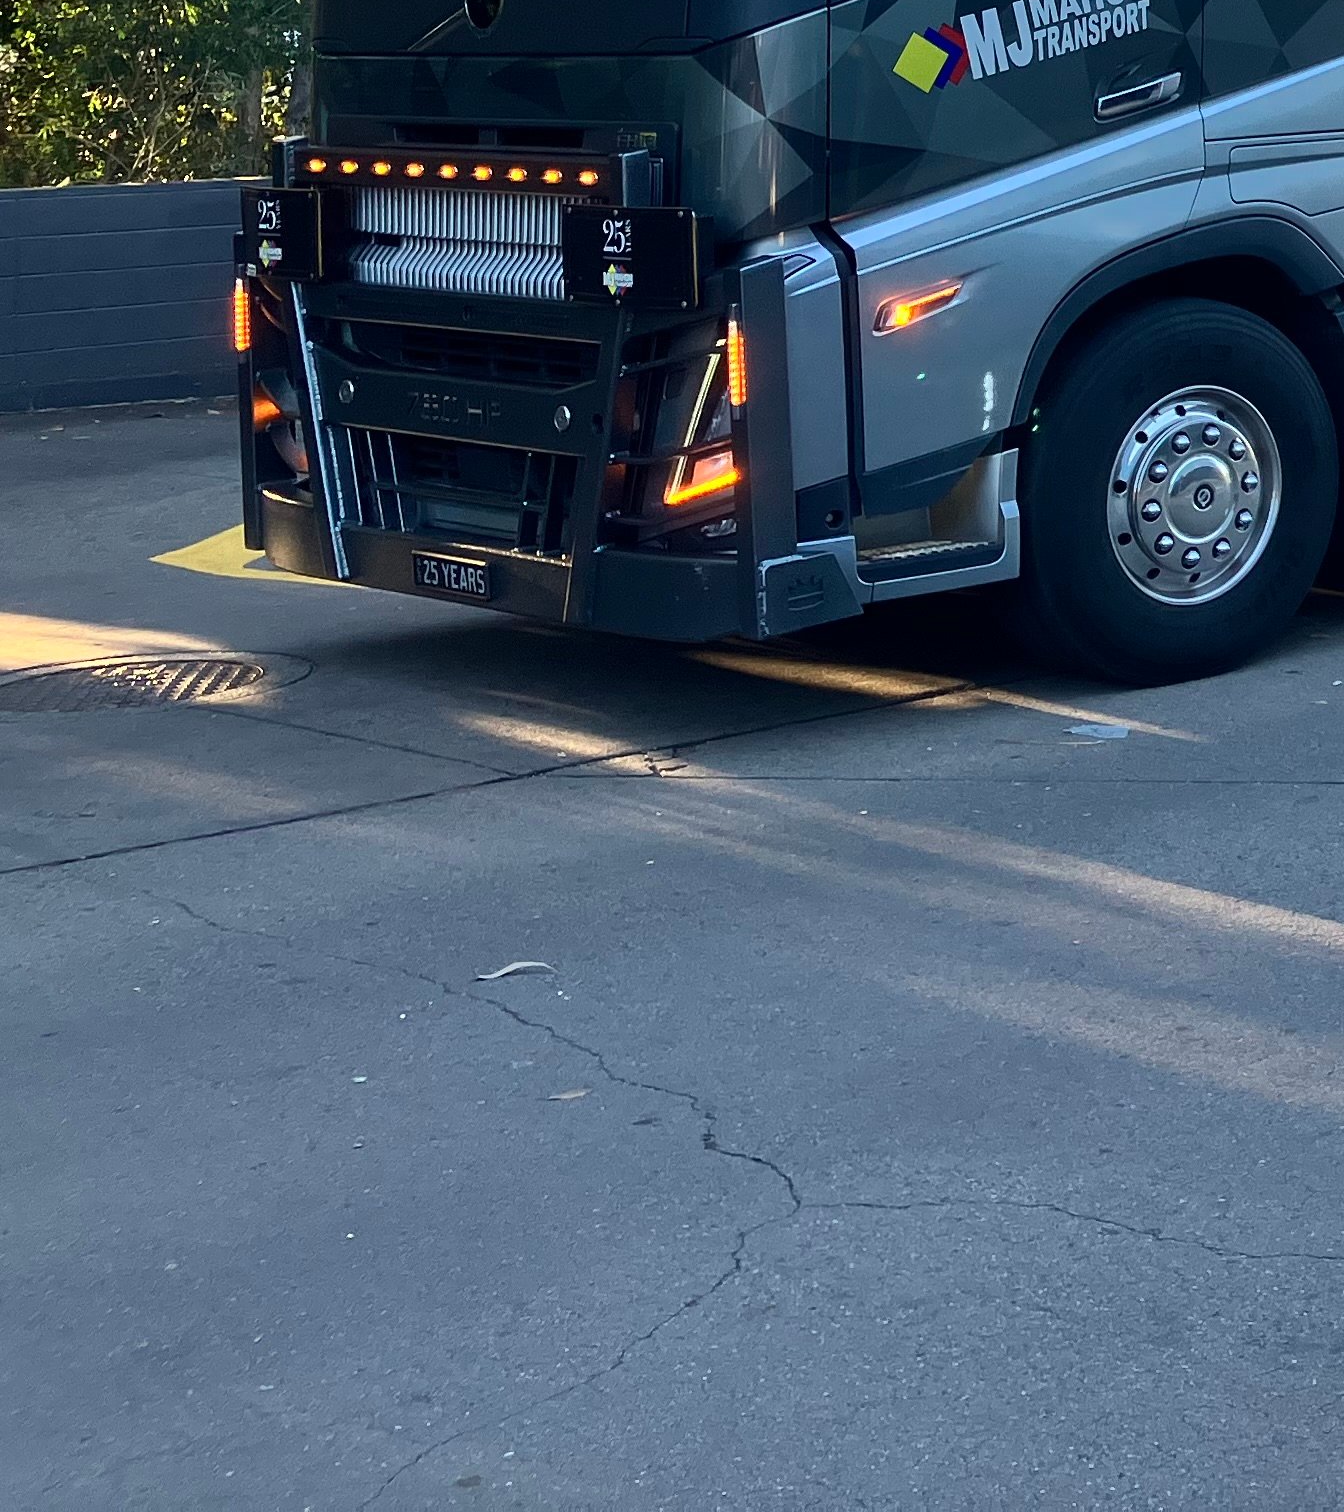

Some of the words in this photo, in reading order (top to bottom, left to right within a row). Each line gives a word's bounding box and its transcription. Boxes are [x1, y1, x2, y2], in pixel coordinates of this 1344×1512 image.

[959, 0, 1034, 81] MJ
[257, 199, 277, 230] 25
[602, 218, 626, 254] 25
[423, 559, 440, 585] 25
[441, 562, 486, 595] YEARS
